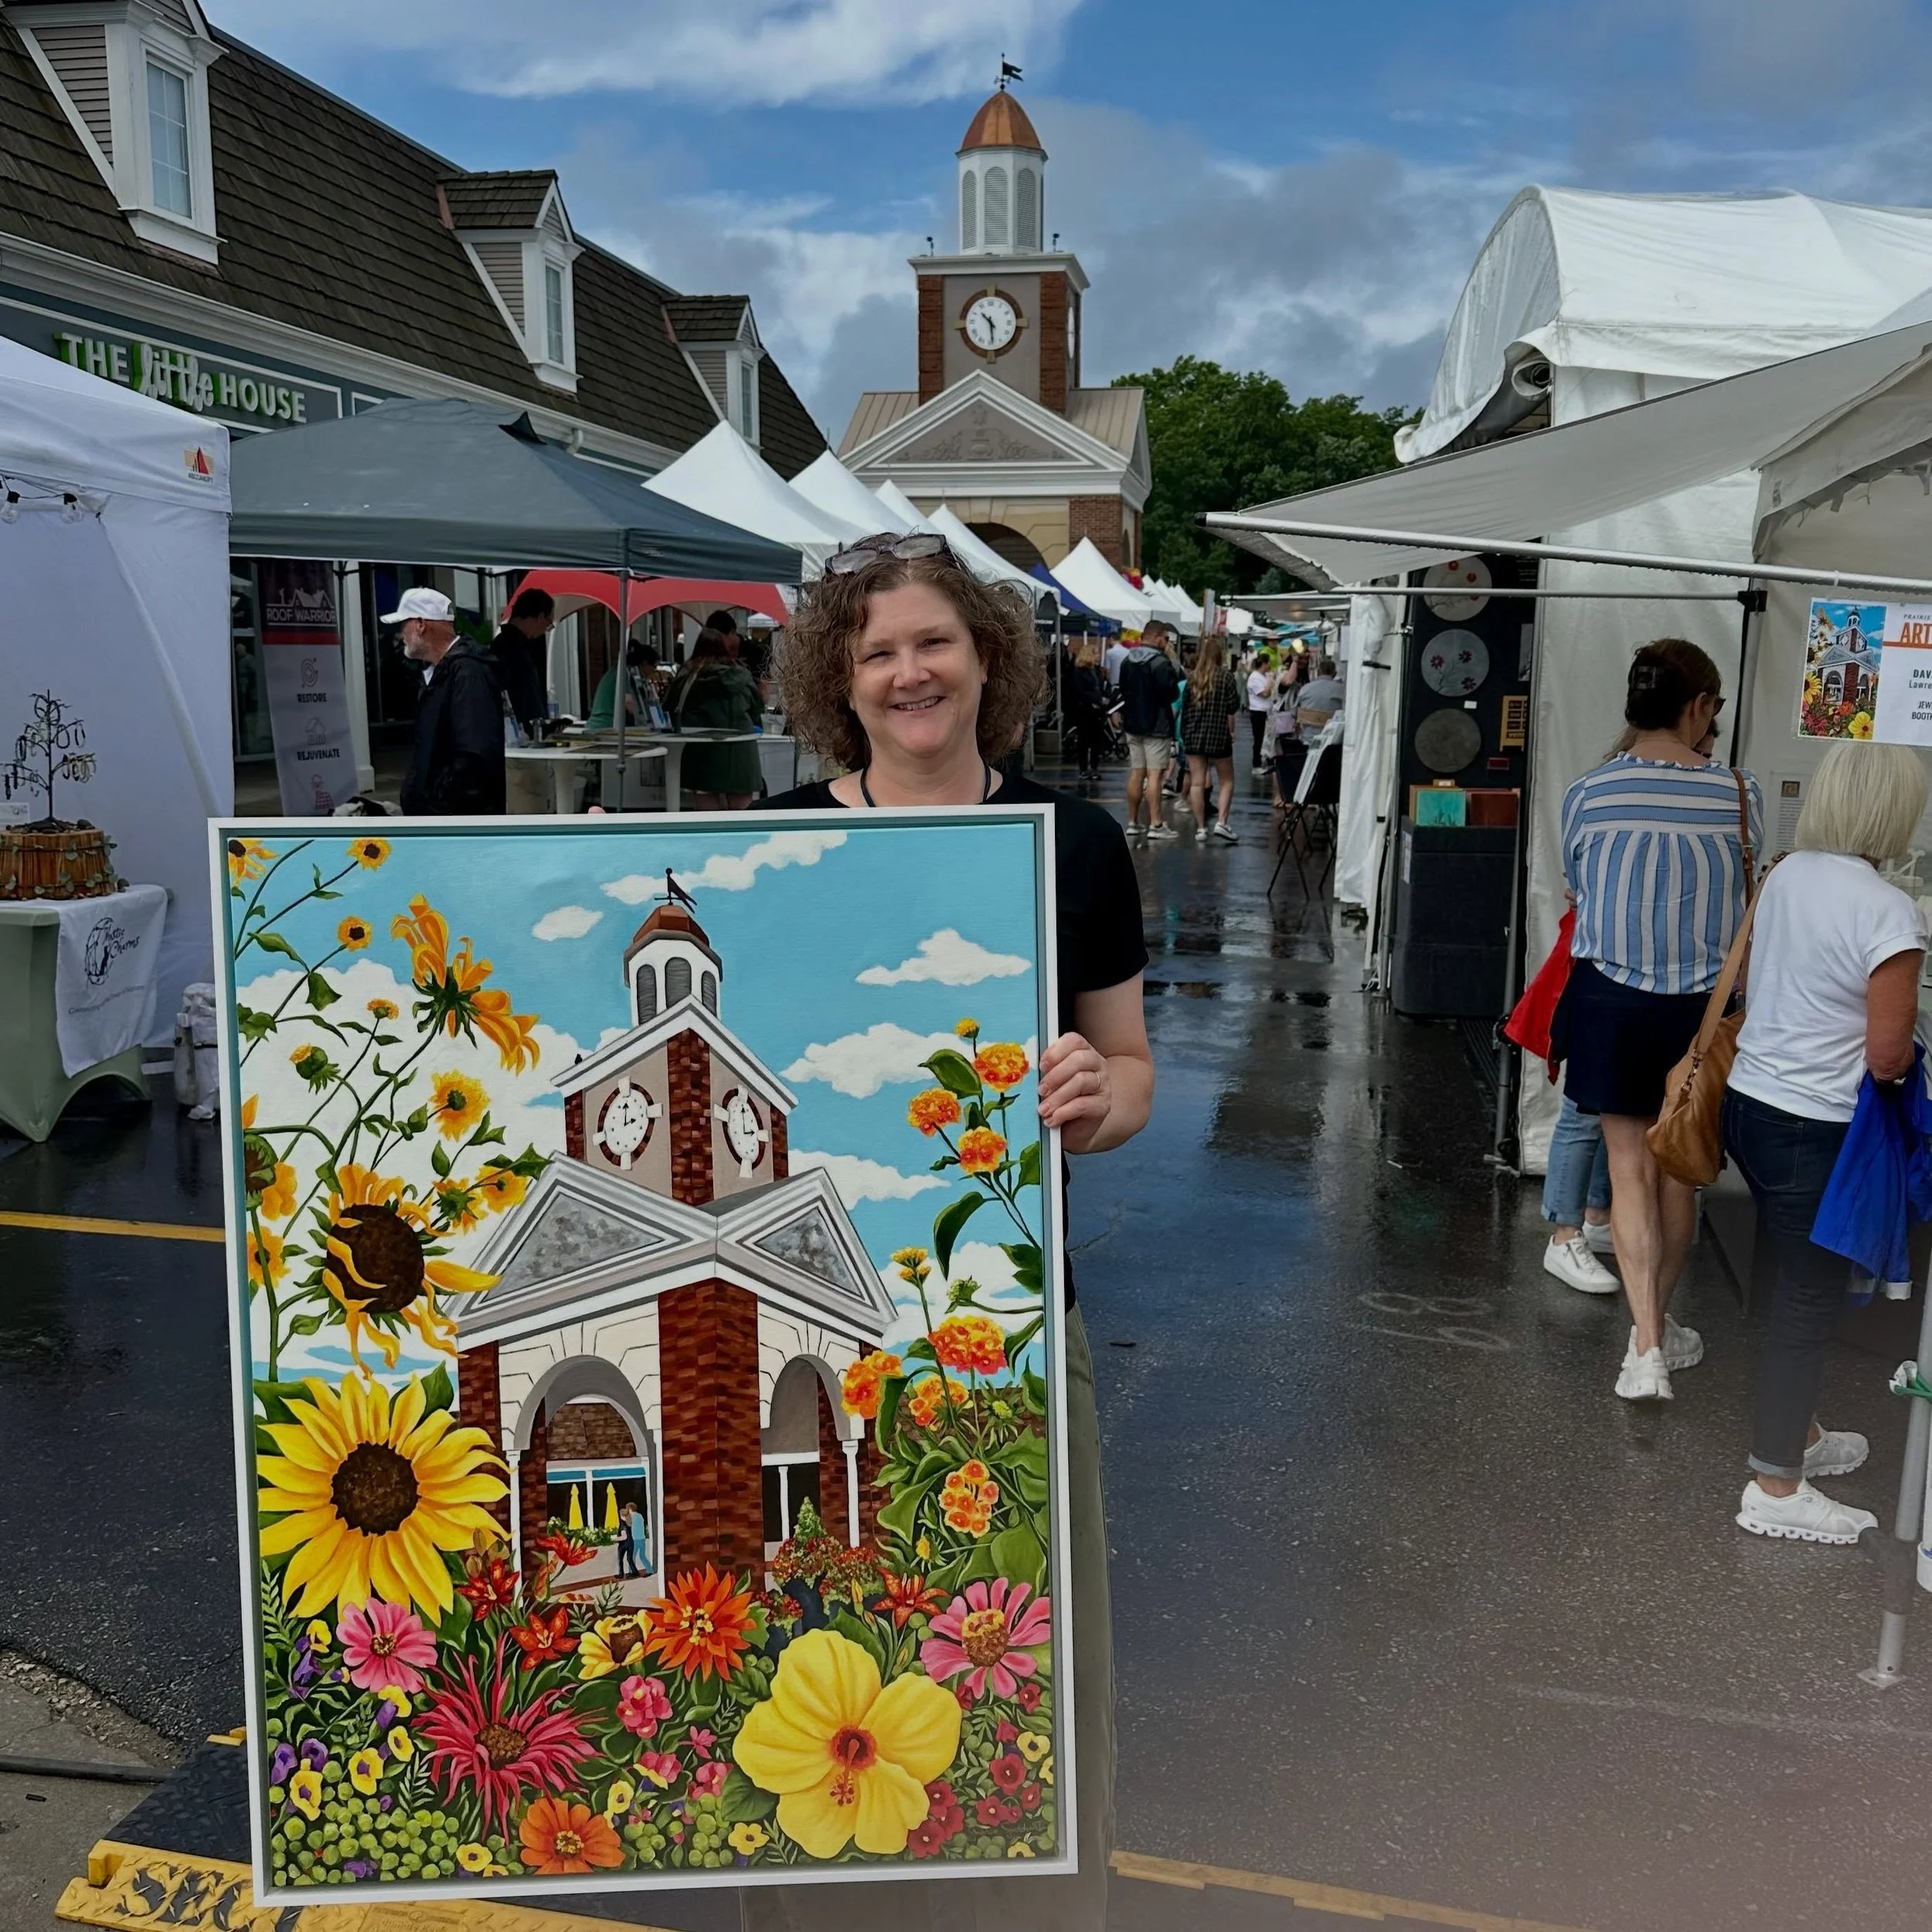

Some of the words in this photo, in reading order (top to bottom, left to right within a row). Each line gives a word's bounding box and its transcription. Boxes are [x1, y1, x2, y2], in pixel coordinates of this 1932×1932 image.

[60, 332, 130, 383] THE
[138, 342, 214, 412] little
[219, 372, 307, 423] HOUSE
[267, 608, 293, 621] ROOF
[1900, 621, 1932, 645] ART
[297, 693, 327, 703] RESTORE
[1918, 701, 1932, 709] JEW
[297, 748, 340, 761] REJUVENATE
[109, 936, 140, 959] Charms
